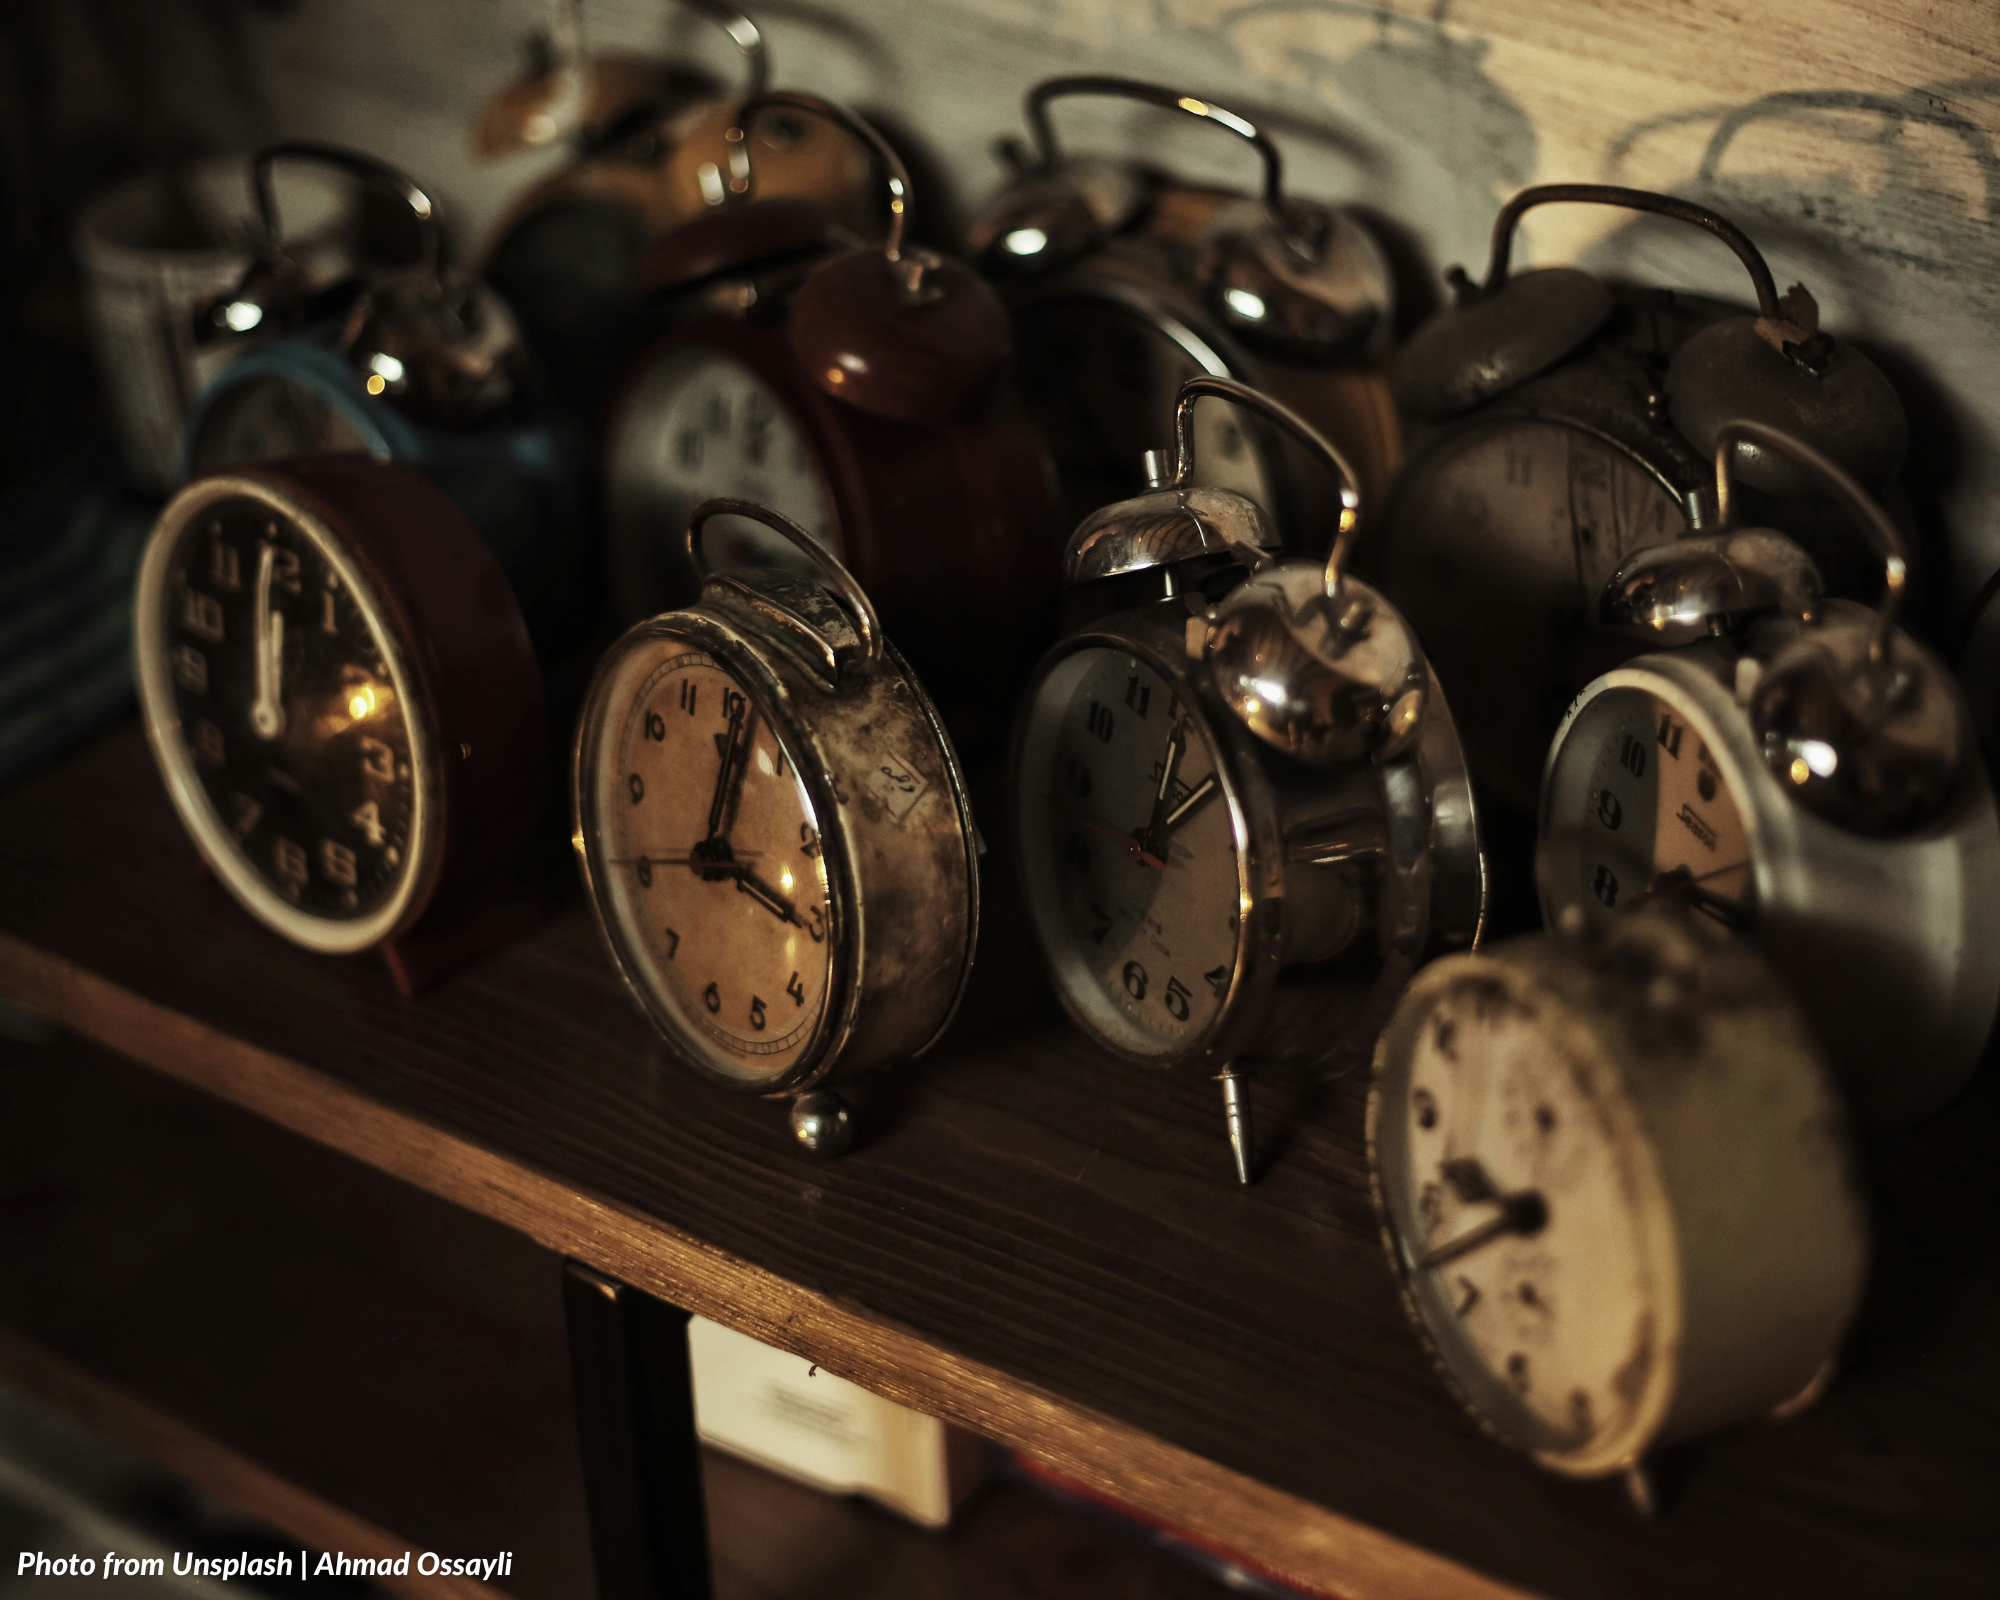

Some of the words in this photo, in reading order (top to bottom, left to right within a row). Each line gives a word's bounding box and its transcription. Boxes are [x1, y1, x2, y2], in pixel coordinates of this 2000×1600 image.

[323, 590, 338, 636] 1
[681, 678, 698, 716] 11
[1124, 675, 1151, 720] 11
[645, 710, 666, 742] 10
[1087, 701, 1114, 744] 10
[1656, 714, 1683, 761] 11
[359, 735, 395, 783] 3
[1619, 733, 1647, 778] 10
[628, 772, 644, 805] 9
[351, 800, 387, 847] 4
[1597, 789, 1622, 831] 9
[1593, 864, 1619, 908] 8
[665, 927, 681, 960] 7
[809, 904, 826, 943] 3
[1088, 903, 1113, 945] 7
[704, 981, 721, 1014] 6
[786, 970, 805, 1007] 4
[1122, 959, 1149, 1000] 6
[1164, 974, 1193, 1022] 5
[750, 994, 767, 1031] 5
